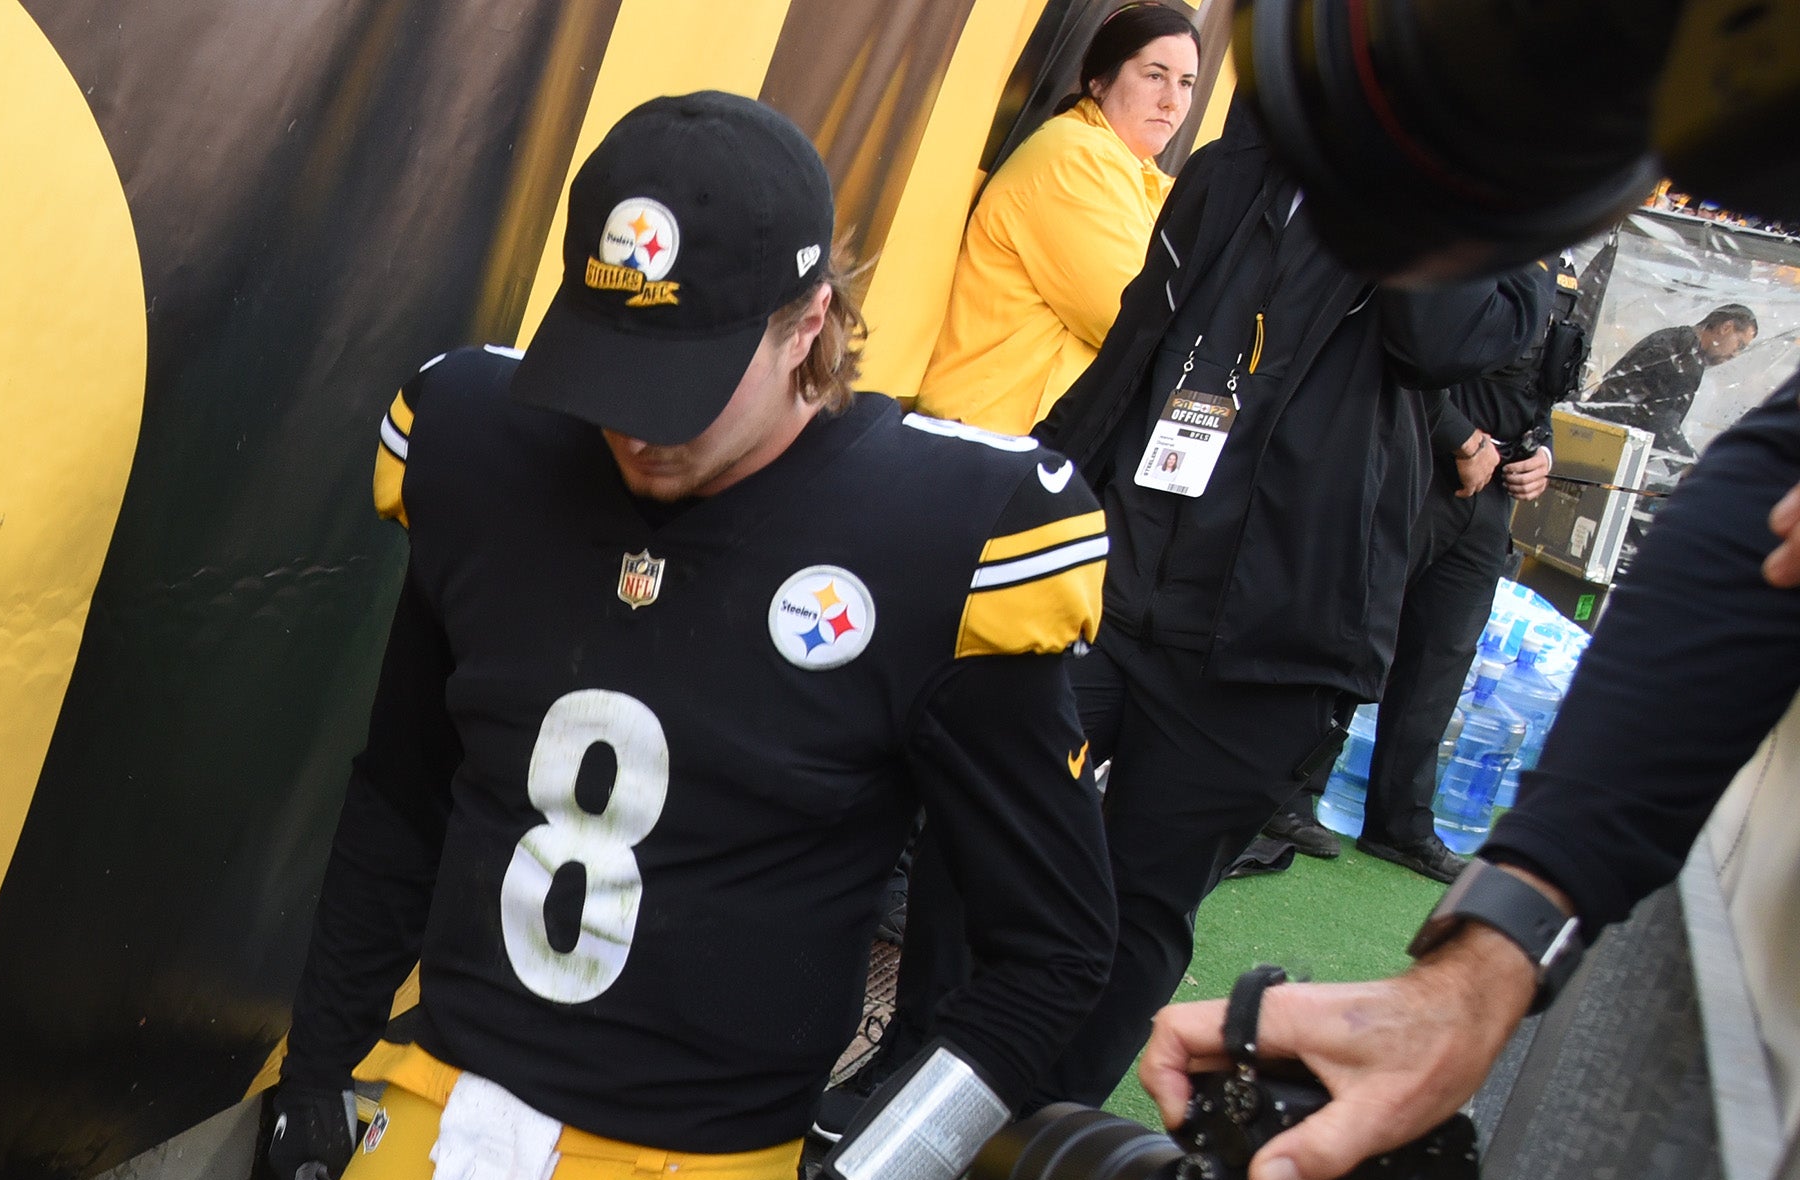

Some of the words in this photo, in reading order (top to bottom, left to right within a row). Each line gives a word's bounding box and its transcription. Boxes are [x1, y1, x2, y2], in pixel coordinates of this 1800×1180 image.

[1171, 409, 1220, 428] OFFICIAL
[624, 575, 651, 597] NFL
[780, 600, 818, 620] Steelers
[500, 688, 669, 1004] 8
